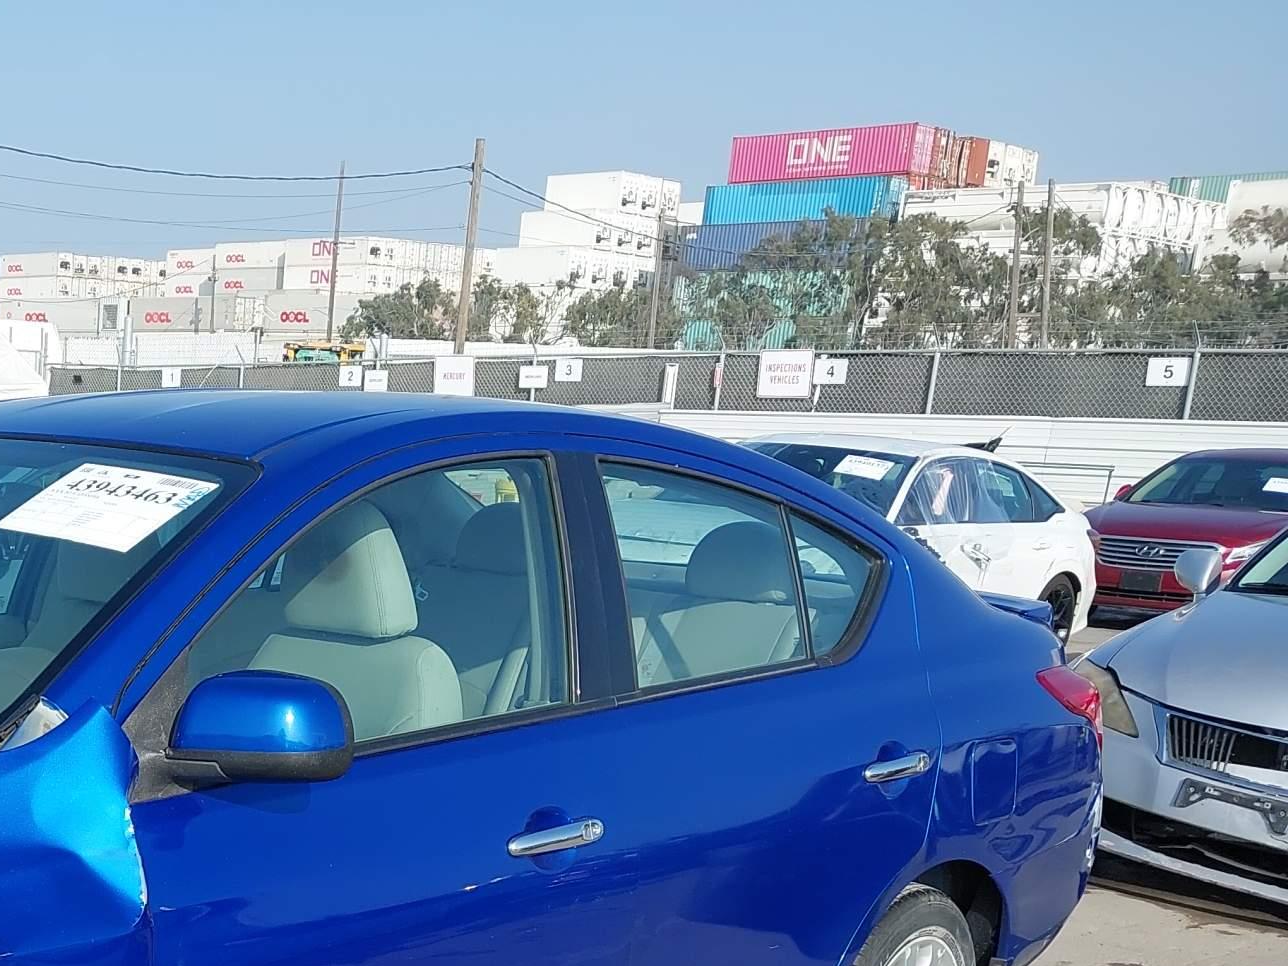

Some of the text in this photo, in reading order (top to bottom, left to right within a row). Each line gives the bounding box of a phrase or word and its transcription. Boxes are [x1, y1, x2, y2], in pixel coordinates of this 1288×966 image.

[787, 134, 852, 165] ONE
[226, 254, 246, 263] OOCL
[8, 264, 24, 273] OOCL
[176, 260, 194, 269] OOCL
[175, 285, 194, 294] OOCL
[224, 280, 244, 289] OOCL
[7, 287, 23, 296] OOCL
[24, 312, 49, 323] OOCL
[144, 312, 172, 324] OOCL
[280, 311, 310, 324] OOCL
[565, 364, 573, 376] 3
[765, 363, 807, 373] INSPECTIONS
[826, 365, 835, 378] 4
[1163, 365, 1174, 379] 5
[169, 372, 174, 385] 1
[347, 370, 354, 382] 2
[769, 375, 800, 385] VEHICLES
[66, 478, 178, 505] 43943463
